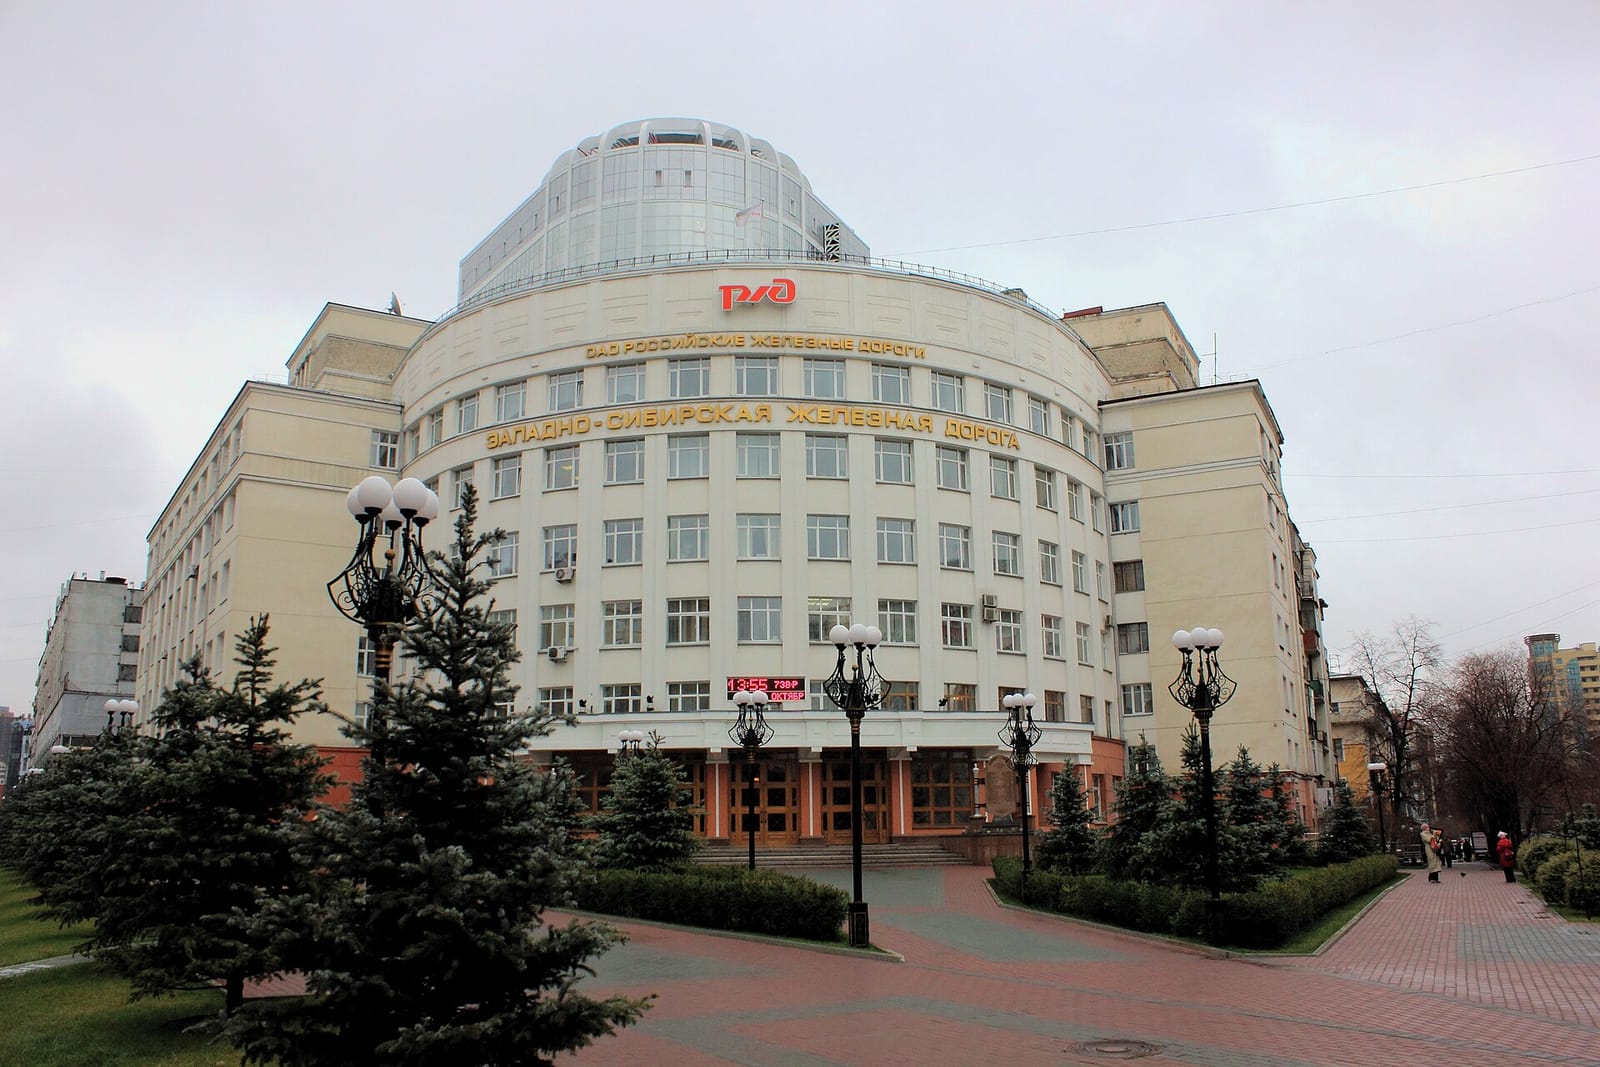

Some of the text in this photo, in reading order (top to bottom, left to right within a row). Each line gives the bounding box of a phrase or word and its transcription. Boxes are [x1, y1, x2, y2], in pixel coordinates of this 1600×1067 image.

[718, 278, 796, 311] РЖД
[586, 333, 926, 359] ОАО РОССИЙСКИЕ ЖЕЛЕЗНЫЕ ДОРОГИ
[786, 404, 934, 433] ЖЕЛЕЗНАЯ
[945, 418, 1021, 450] ДОРОГА
[727, 678, 768, 692] 13:55
